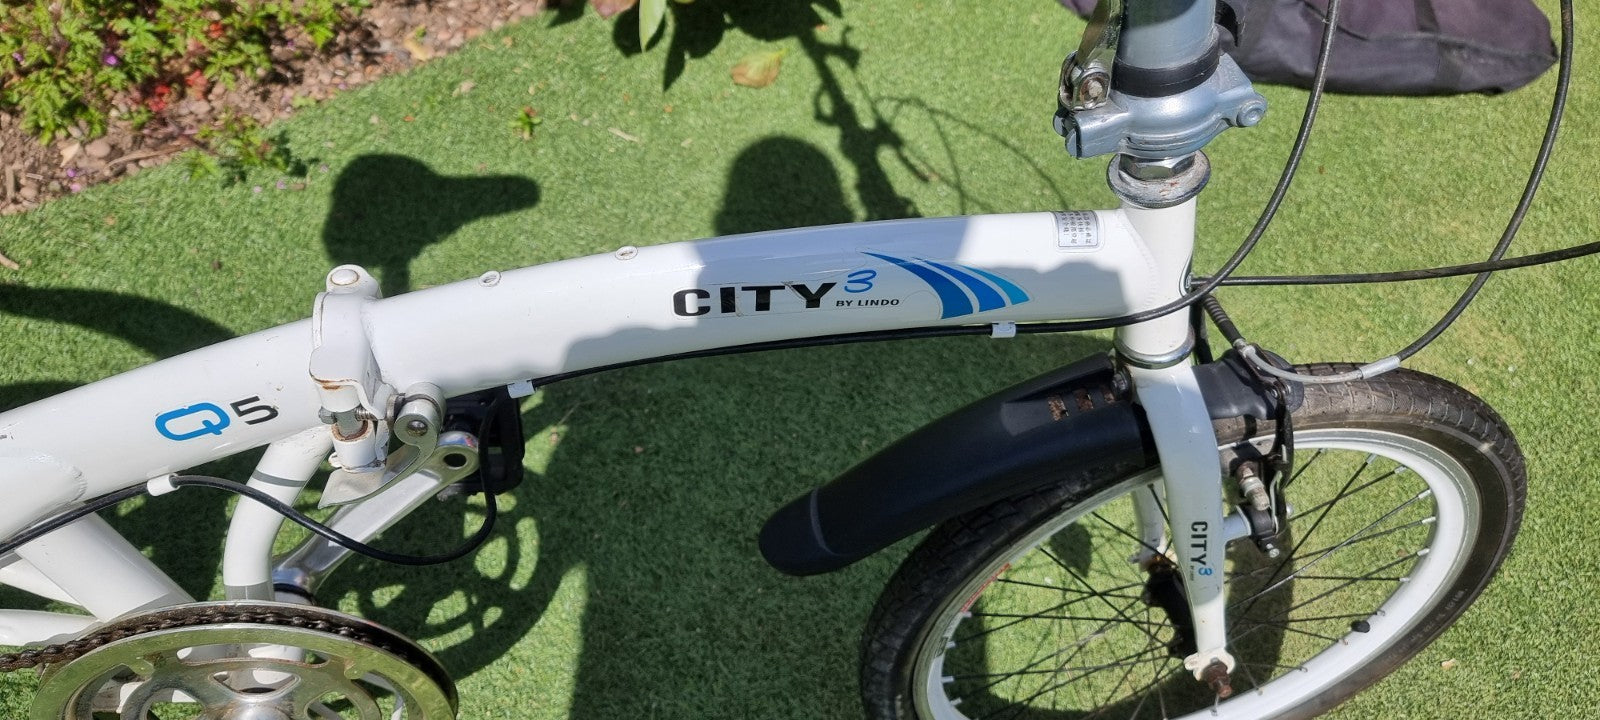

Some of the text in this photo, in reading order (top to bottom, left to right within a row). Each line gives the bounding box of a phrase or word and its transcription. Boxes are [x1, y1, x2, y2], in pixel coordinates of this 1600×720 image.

[673, 282, 837, 316] CITY
[836, 298, 900, 307] BY LINDO
[1191, 521, 1208, 565] CITY
